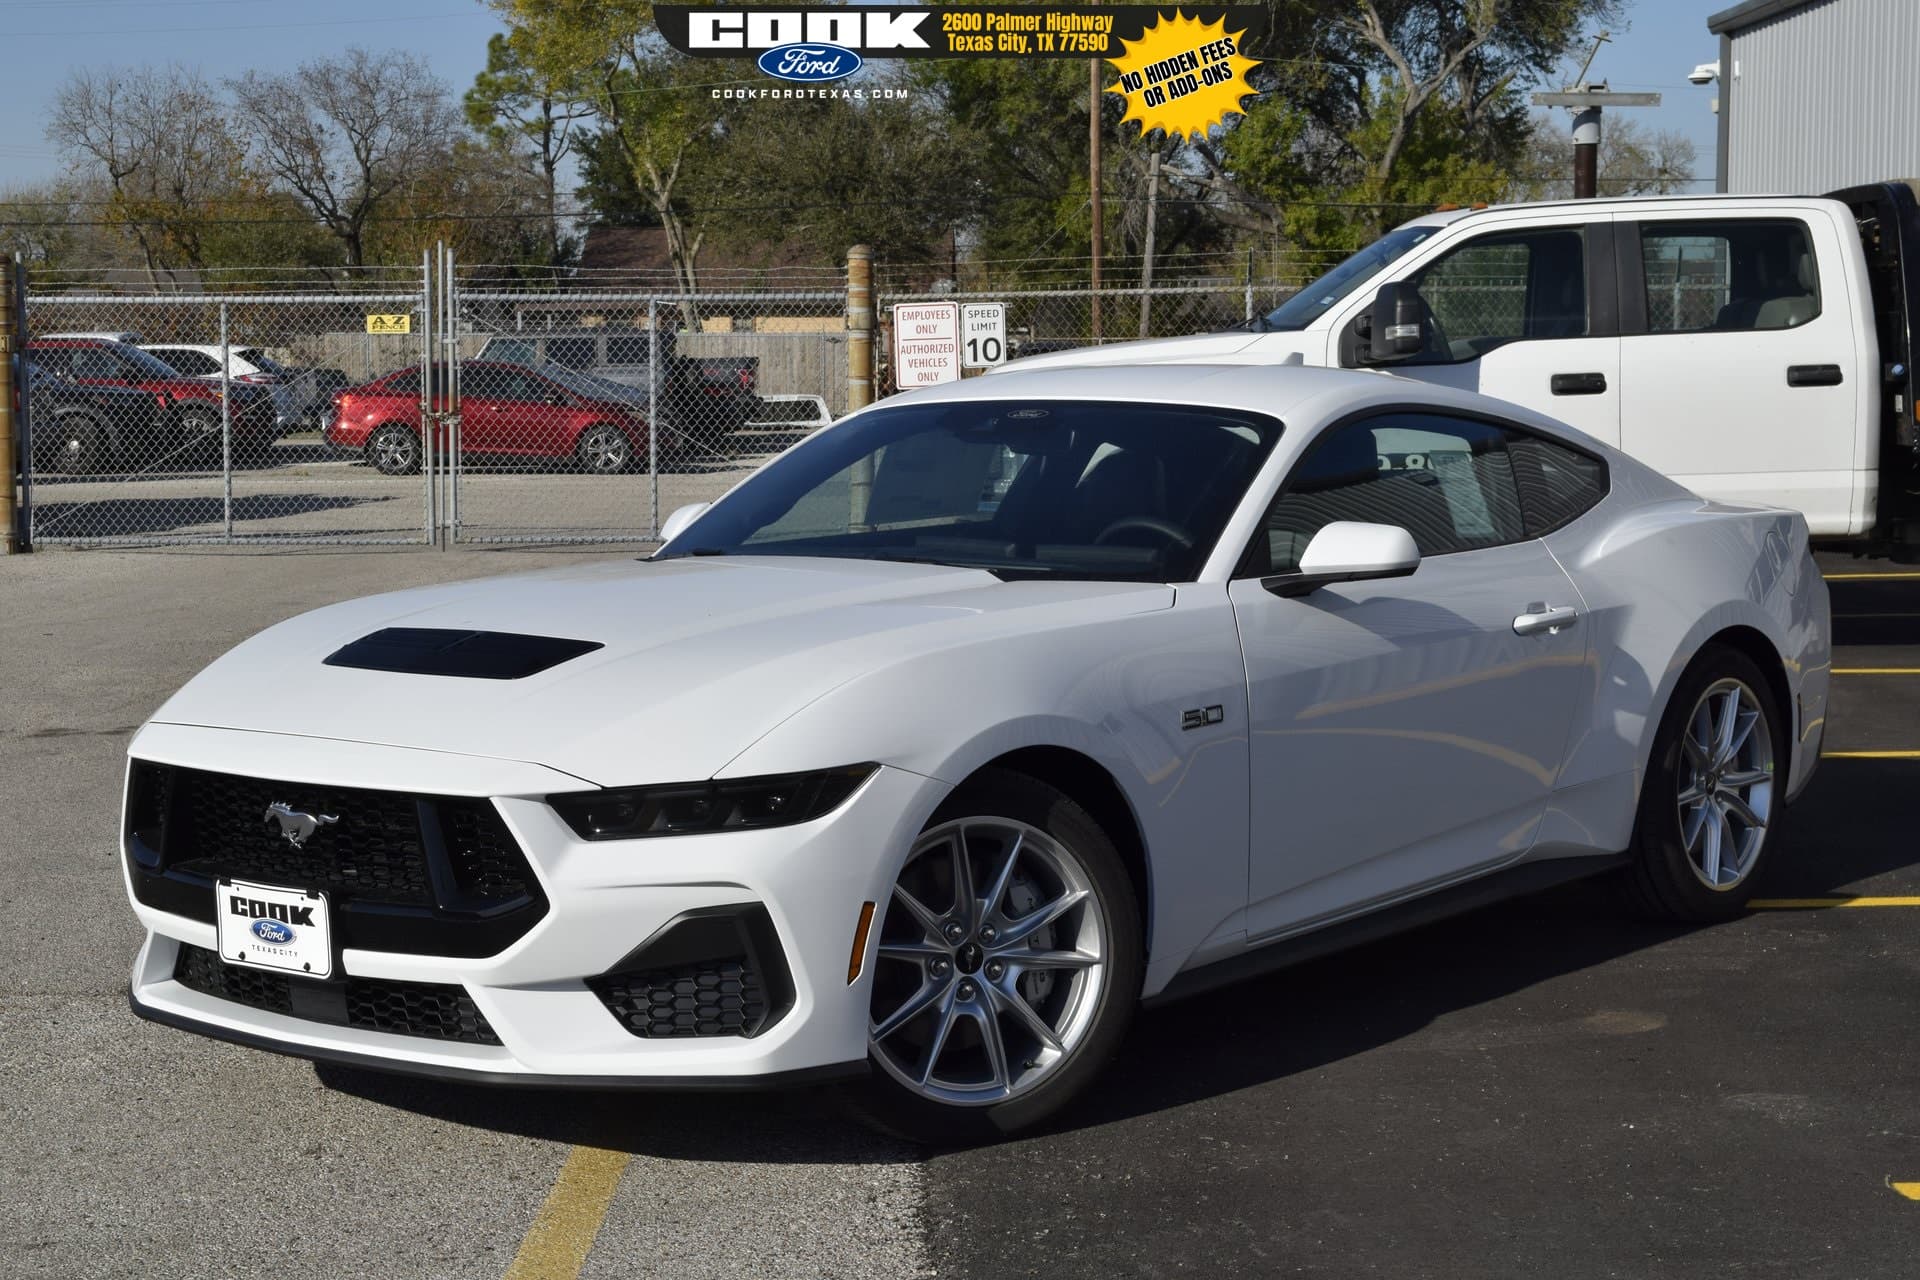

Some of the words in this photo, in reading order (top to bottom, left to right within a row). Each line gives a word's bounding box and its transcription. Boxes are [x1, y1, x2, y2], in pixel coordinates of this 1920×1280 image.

[902, 310, 951, 321] EMPLOYEES
[968, 310, 1000, 318] SPEED
[915, 324, 938, 334] ONLY
[971, 322, 998, 331] LIMIT
[901, 343, 954, 355] AUTHORIZED
[967, 337, 1001, 362] 10
[908, 358, 948, 368] VEHICLES
[917, 372, 939, 382] ONLY
[230, 895, 315, 927] COOK
[260, 922, 285, 941] Ford
[252, 944, 277, 955] TEXAS
[279, 949, 298, 957] CITY
